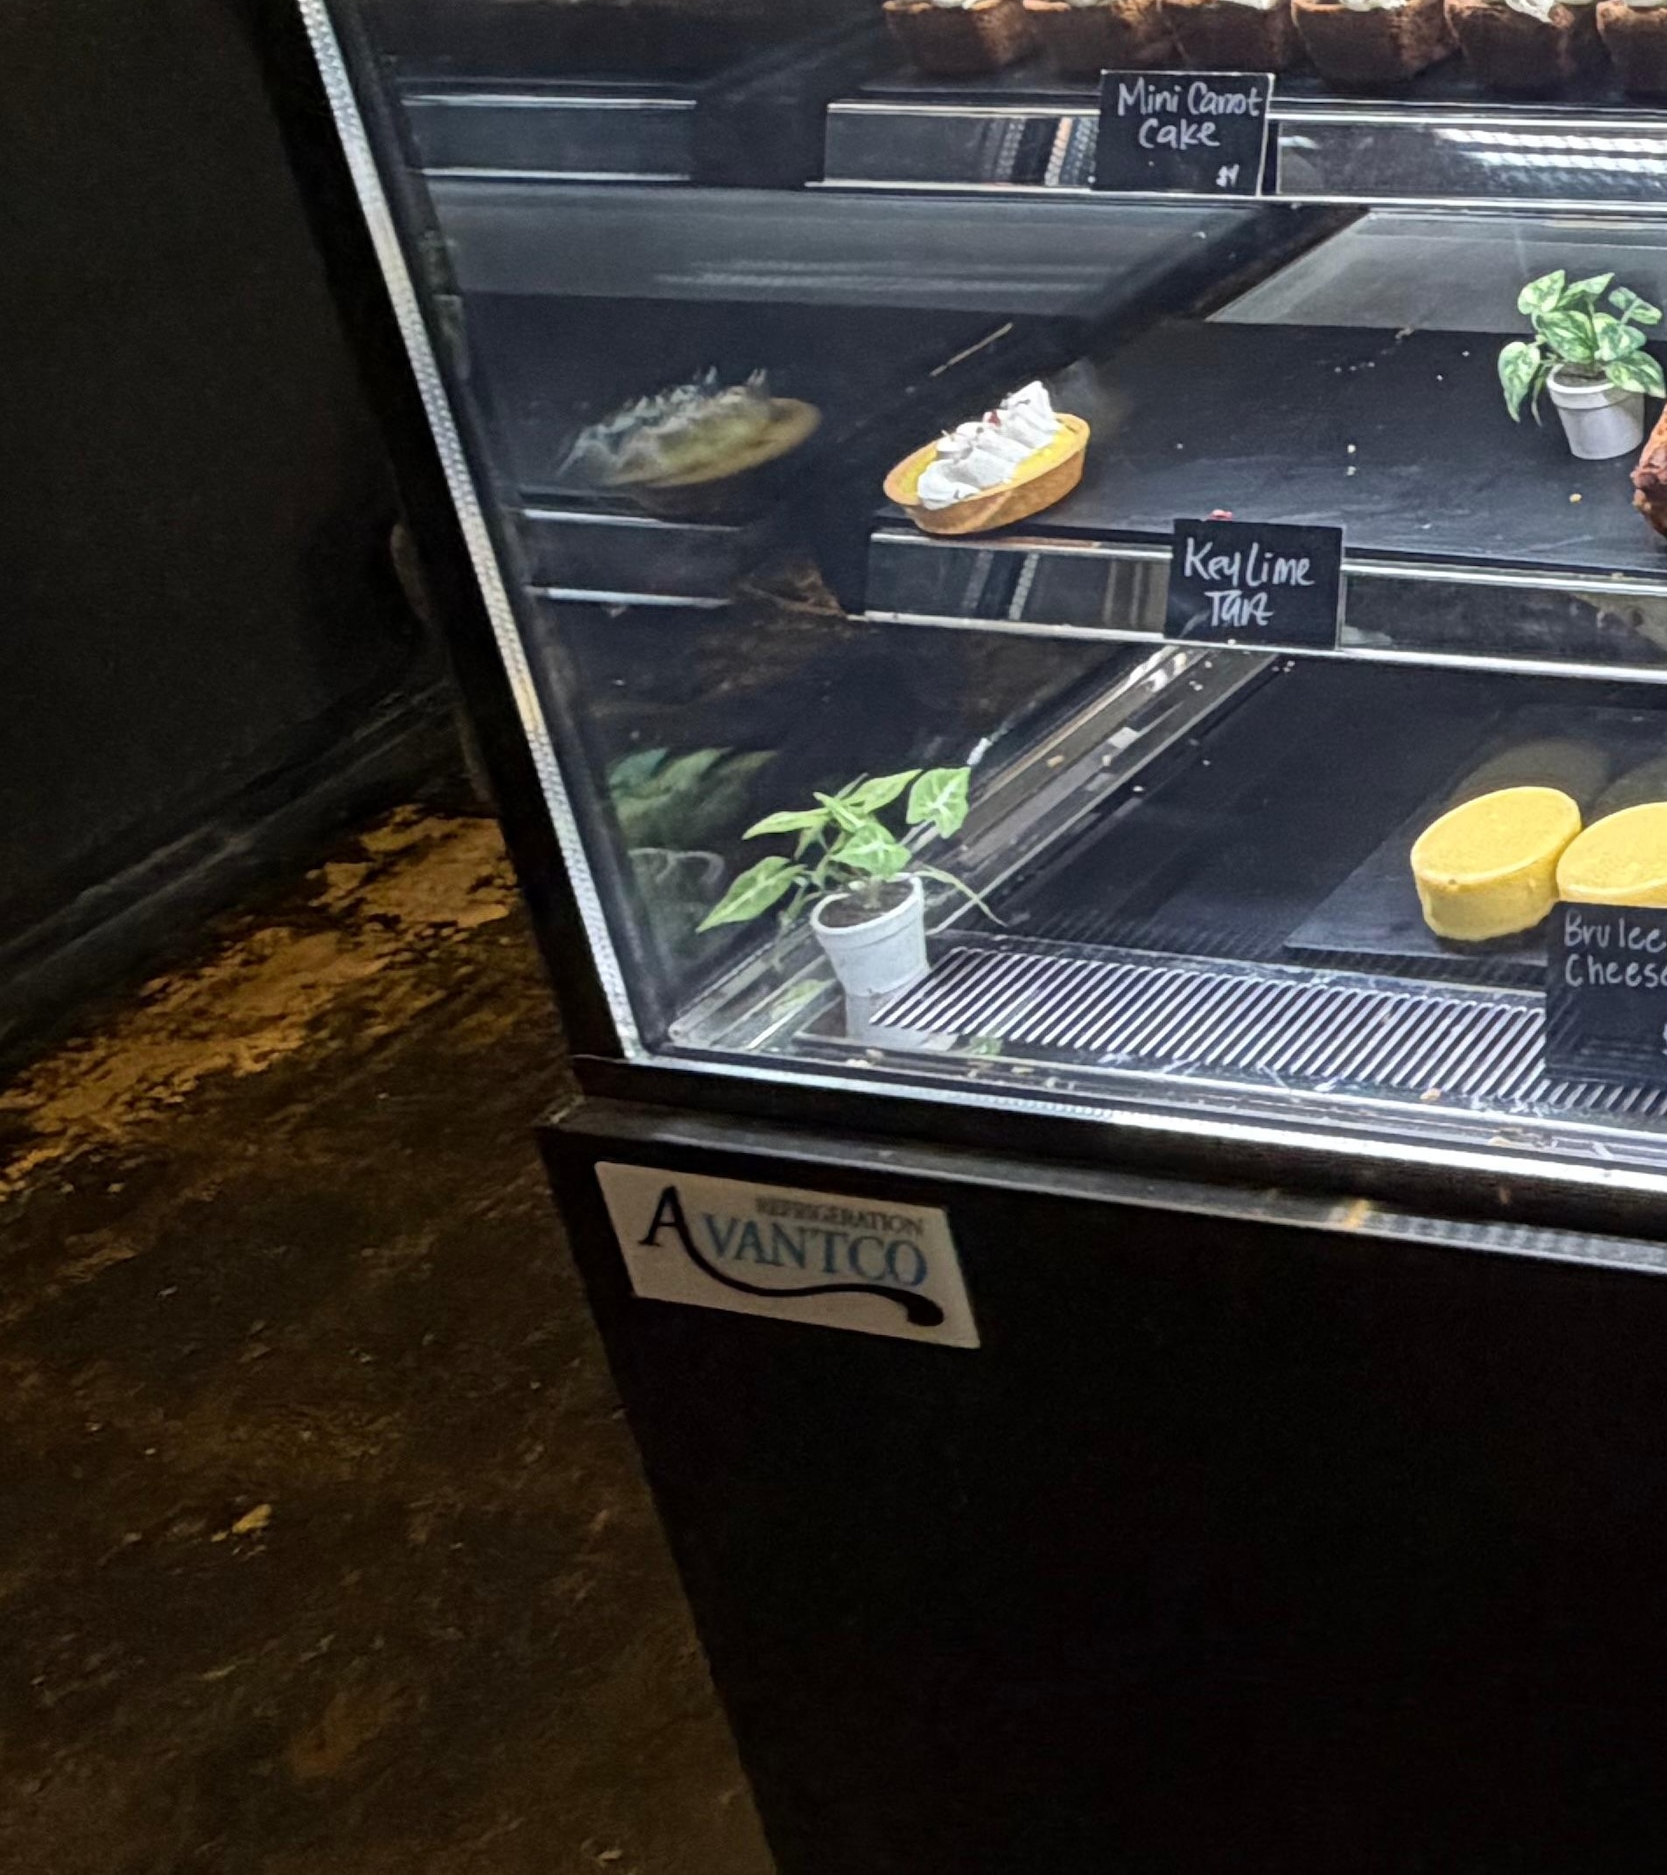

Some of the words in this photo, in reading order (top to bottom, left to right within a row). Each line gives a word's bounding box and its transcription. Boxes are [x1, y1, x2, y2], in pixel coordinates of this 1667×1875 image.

[1117, 75, 1181, 117] Mini
[1187, 80, 1263, 118] Carrot
[1138, 118, 1221, 151] Cake
[1184, 536, 1242, 588] Key
[1246, 541, 1316, 588] Lime
[1204, 589, 1276, 627] Tart
[1563, 907, 1667, 954] Brulee
[638, 1184, 931, 1290] AVANTCO
